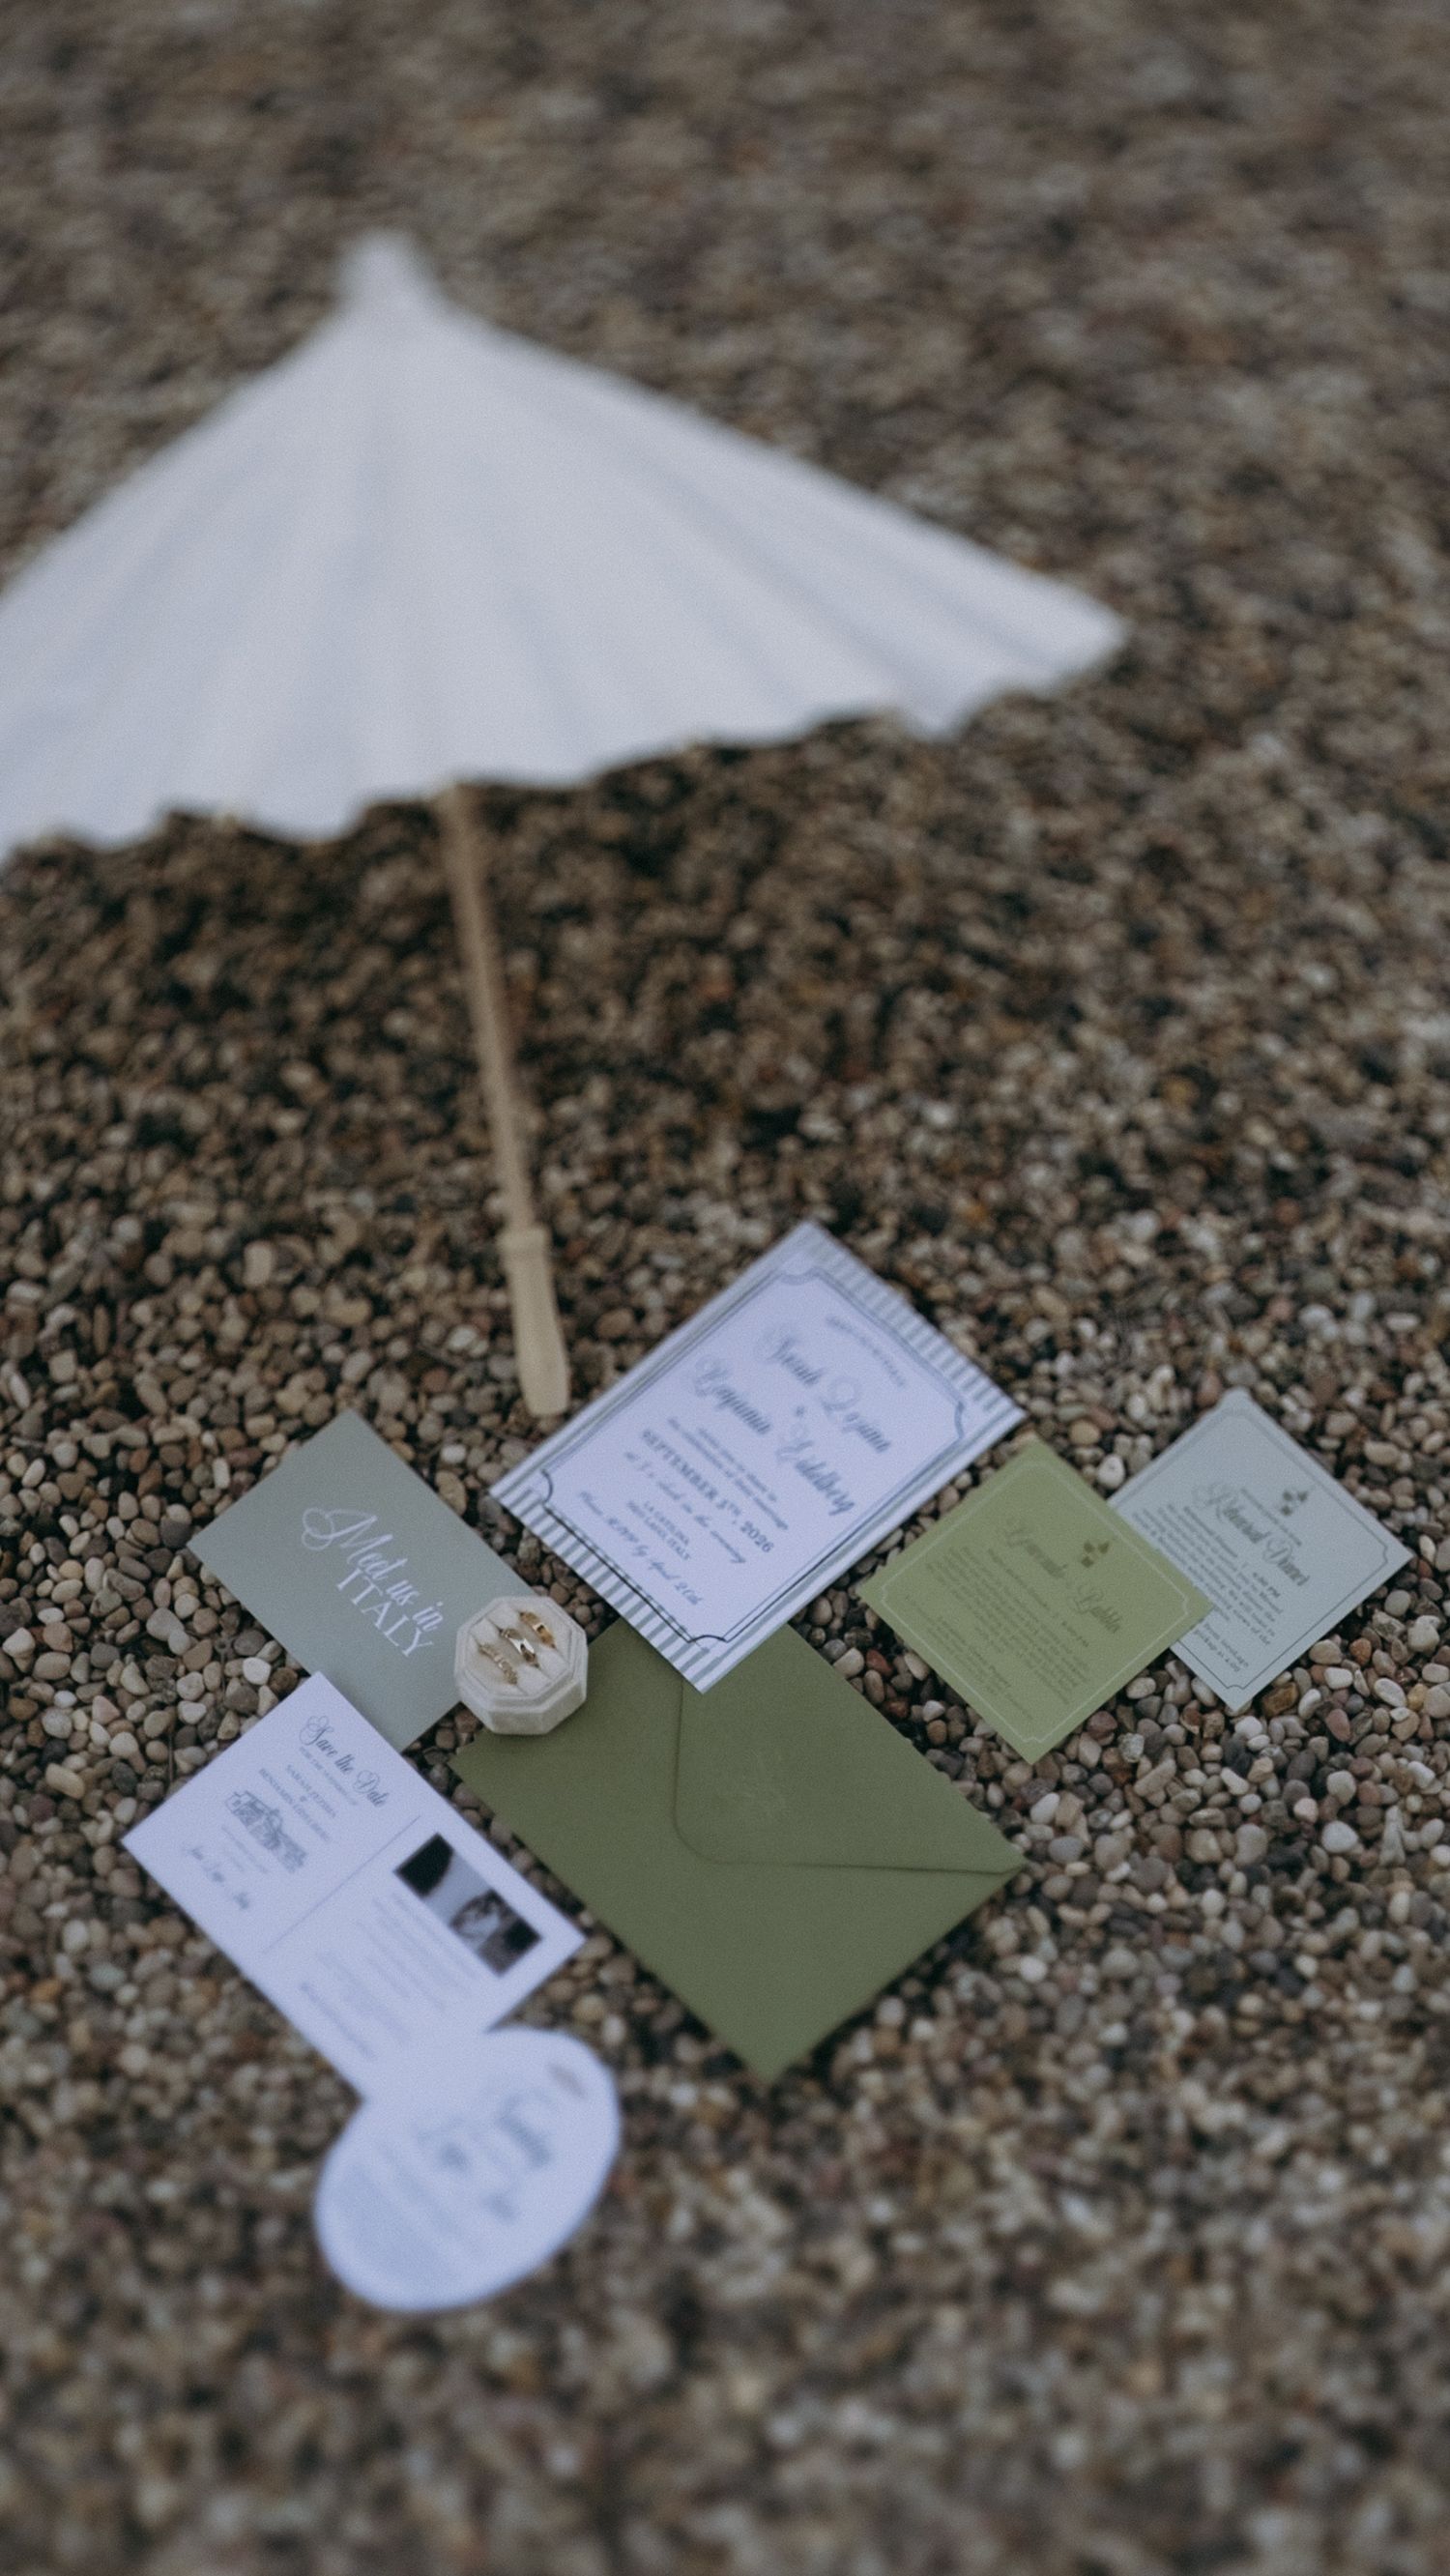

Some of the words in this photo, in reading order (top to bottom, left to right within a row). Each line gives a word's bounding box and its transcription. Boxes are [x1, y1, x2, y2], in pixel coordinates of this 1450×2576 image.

[640, 1428, 718, 1502] SEPTEMBER
[739, 1520, 774, 1553] 2026
[301, 1507, 407, 1579] Meet
[385, 1578, 420, 1606] us
[411, 1601, 444, 1632] in
[630, 1544, 649, 1557] by
[647, 1558, 681, 1580] April
[709, 1529, 746, 1564] evening
[335, 1557, 433, 1657] ITALY
[299, 1715, 338, 1757] Save
[334, 1752, 355, 1774] the
[354, 1770, 390, 1808] Date
